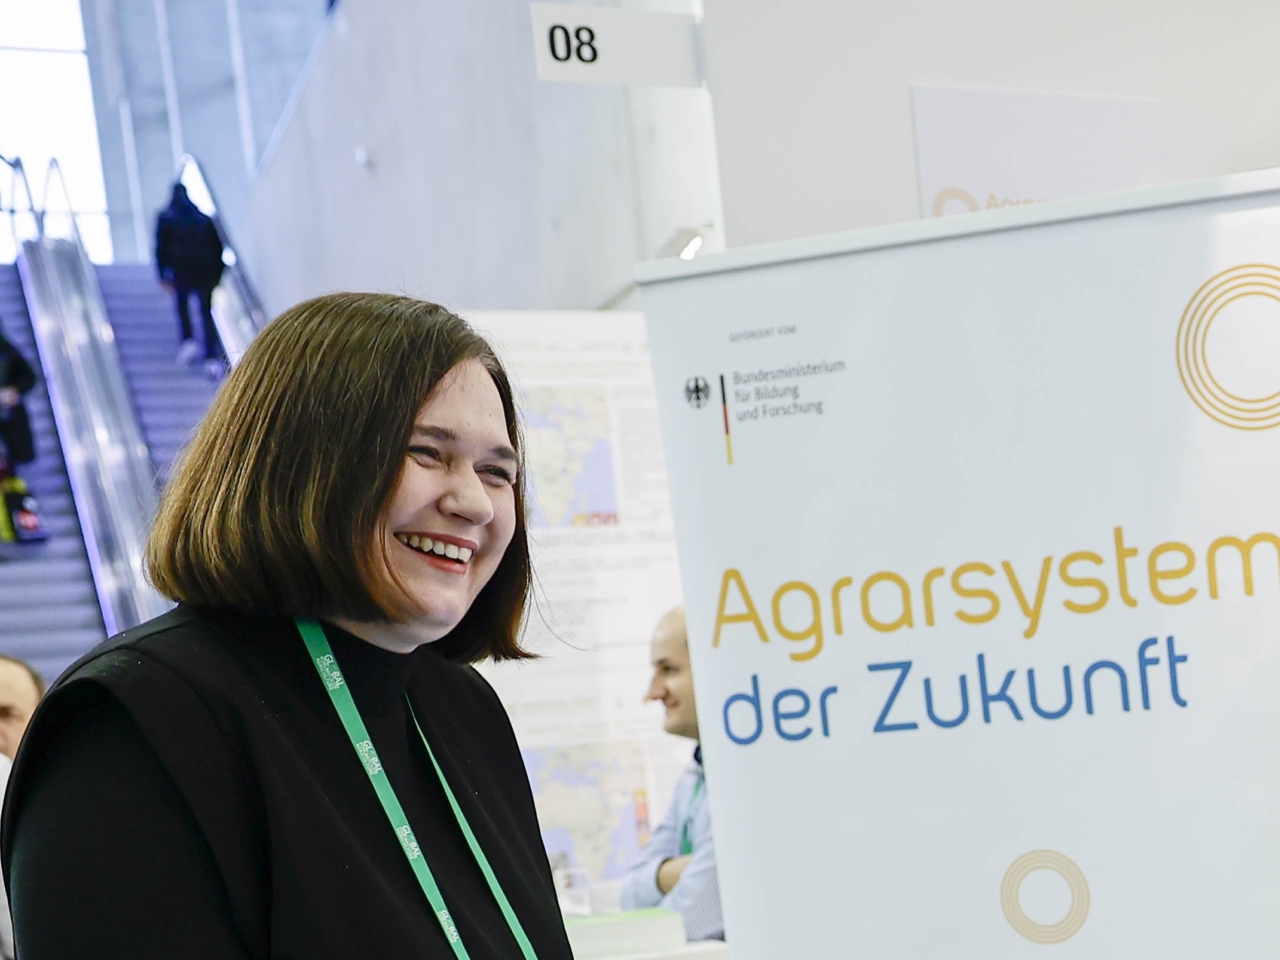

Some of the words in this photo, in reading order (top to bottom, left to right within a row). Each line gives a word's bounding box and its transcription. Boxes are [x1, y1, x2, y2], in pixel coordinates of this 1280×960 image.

[549, 24, 598, 63] 08
[732, 359, 847, 385] Bundesministerium
[734, 388, 751, 403] für
[754, 385, 800, 400] Bildung
[736, 406, 758, 421] und
[761, 401, 824, 417] Forschung
[324, 654, 344, 689] GLBAL
[722, 673, 838, 745] der
[867, 635, 1189, 733] Zukunft
[363, 740, 382, 772] GLBAL
[402, 825, 421, 857] GLBAL
